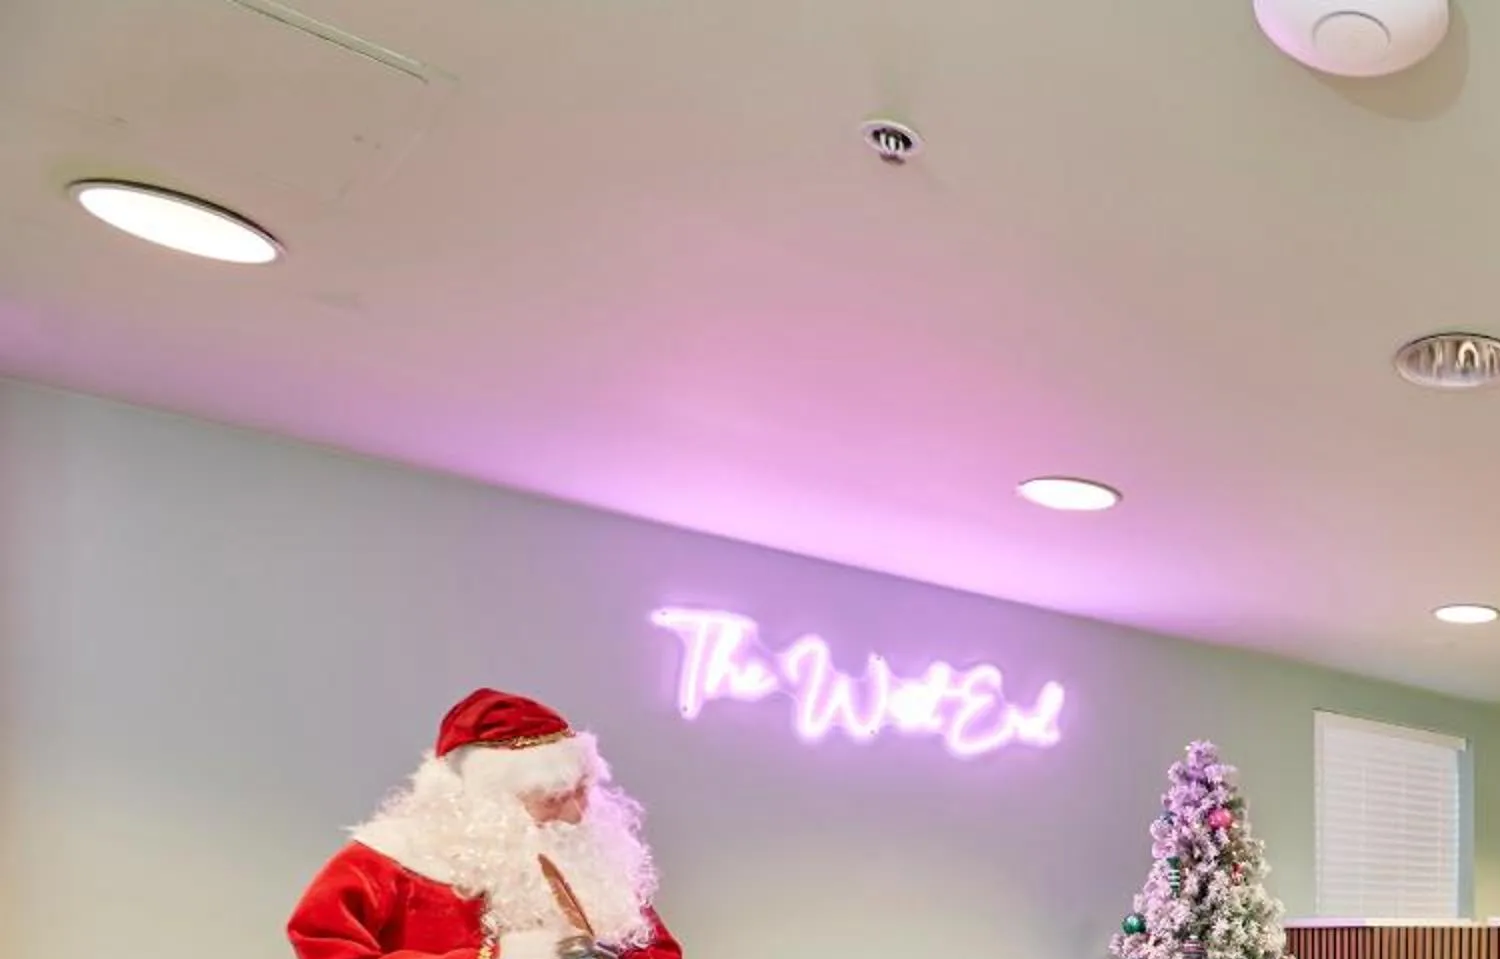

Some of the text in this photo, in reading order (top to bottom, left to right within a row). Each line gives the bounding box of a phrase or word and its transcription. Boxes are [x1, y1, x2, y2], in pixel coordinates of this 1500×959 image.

[650, 607, 1066, 756] The Wt End
